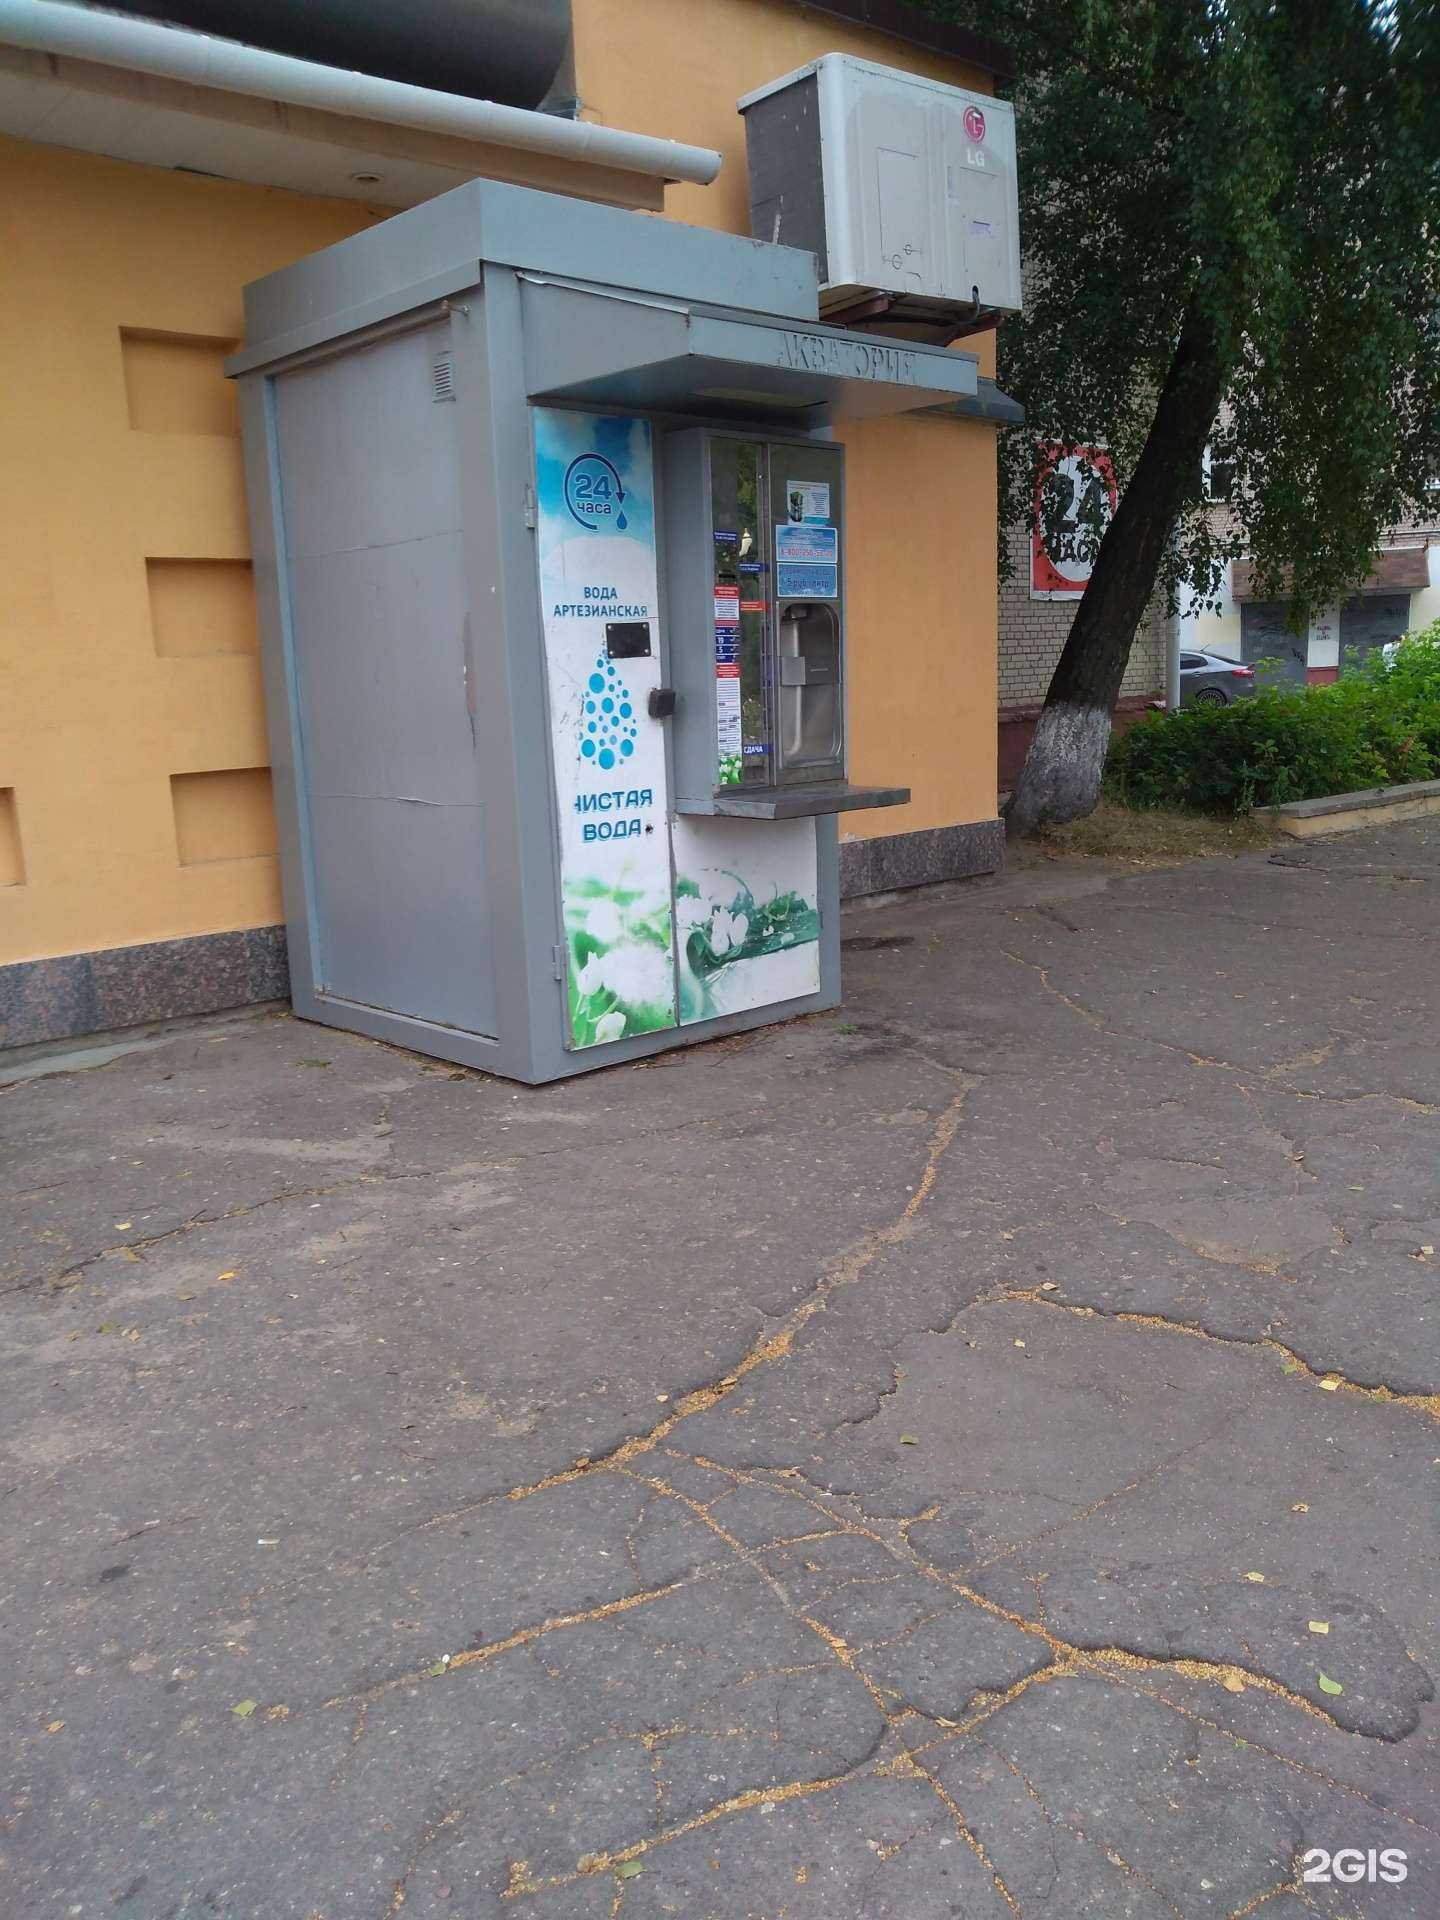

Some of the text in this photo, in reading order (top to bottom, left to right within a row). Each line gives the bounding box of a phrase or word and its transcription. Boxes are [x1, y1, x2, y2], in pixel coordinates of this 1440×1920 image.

[966, 148, 985, 167] LG
[777, 333, 917, 383] АКВАТОРИЯ
[575, 474, 611, 500] 24
[576, 502, 612, 514] часа
[584, 586, 618, 600] ВОДА
[553, 604, 648, 617] АРТЕЗИАНСКАЯ
[583, 818, 642, 842] ВОДА
